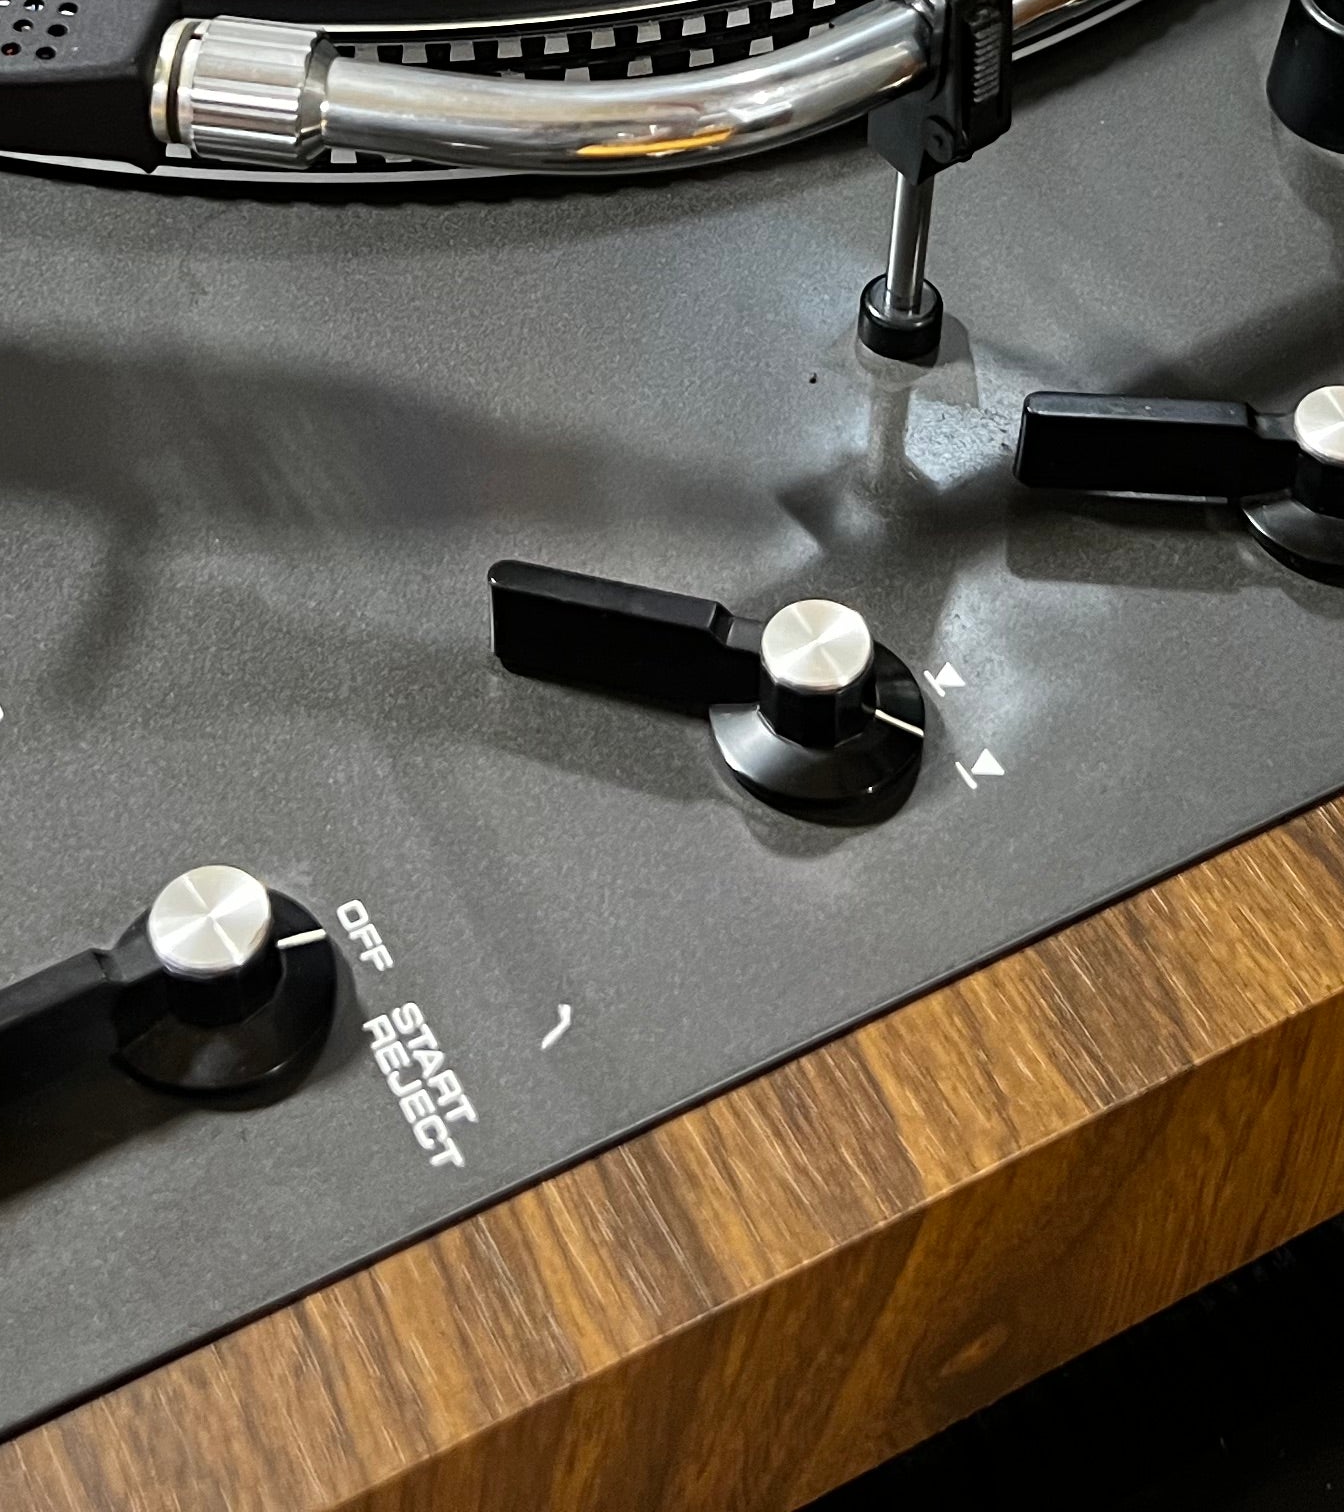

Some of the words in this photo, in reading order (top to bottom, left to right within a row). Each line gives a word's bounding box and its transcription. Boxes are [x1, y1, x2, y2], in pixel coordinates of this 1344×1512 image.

[336, 899, 394, 972] OFF
[363, 1014, 465, 1168] REJECT
[392, 1002, 479, 1123] START
